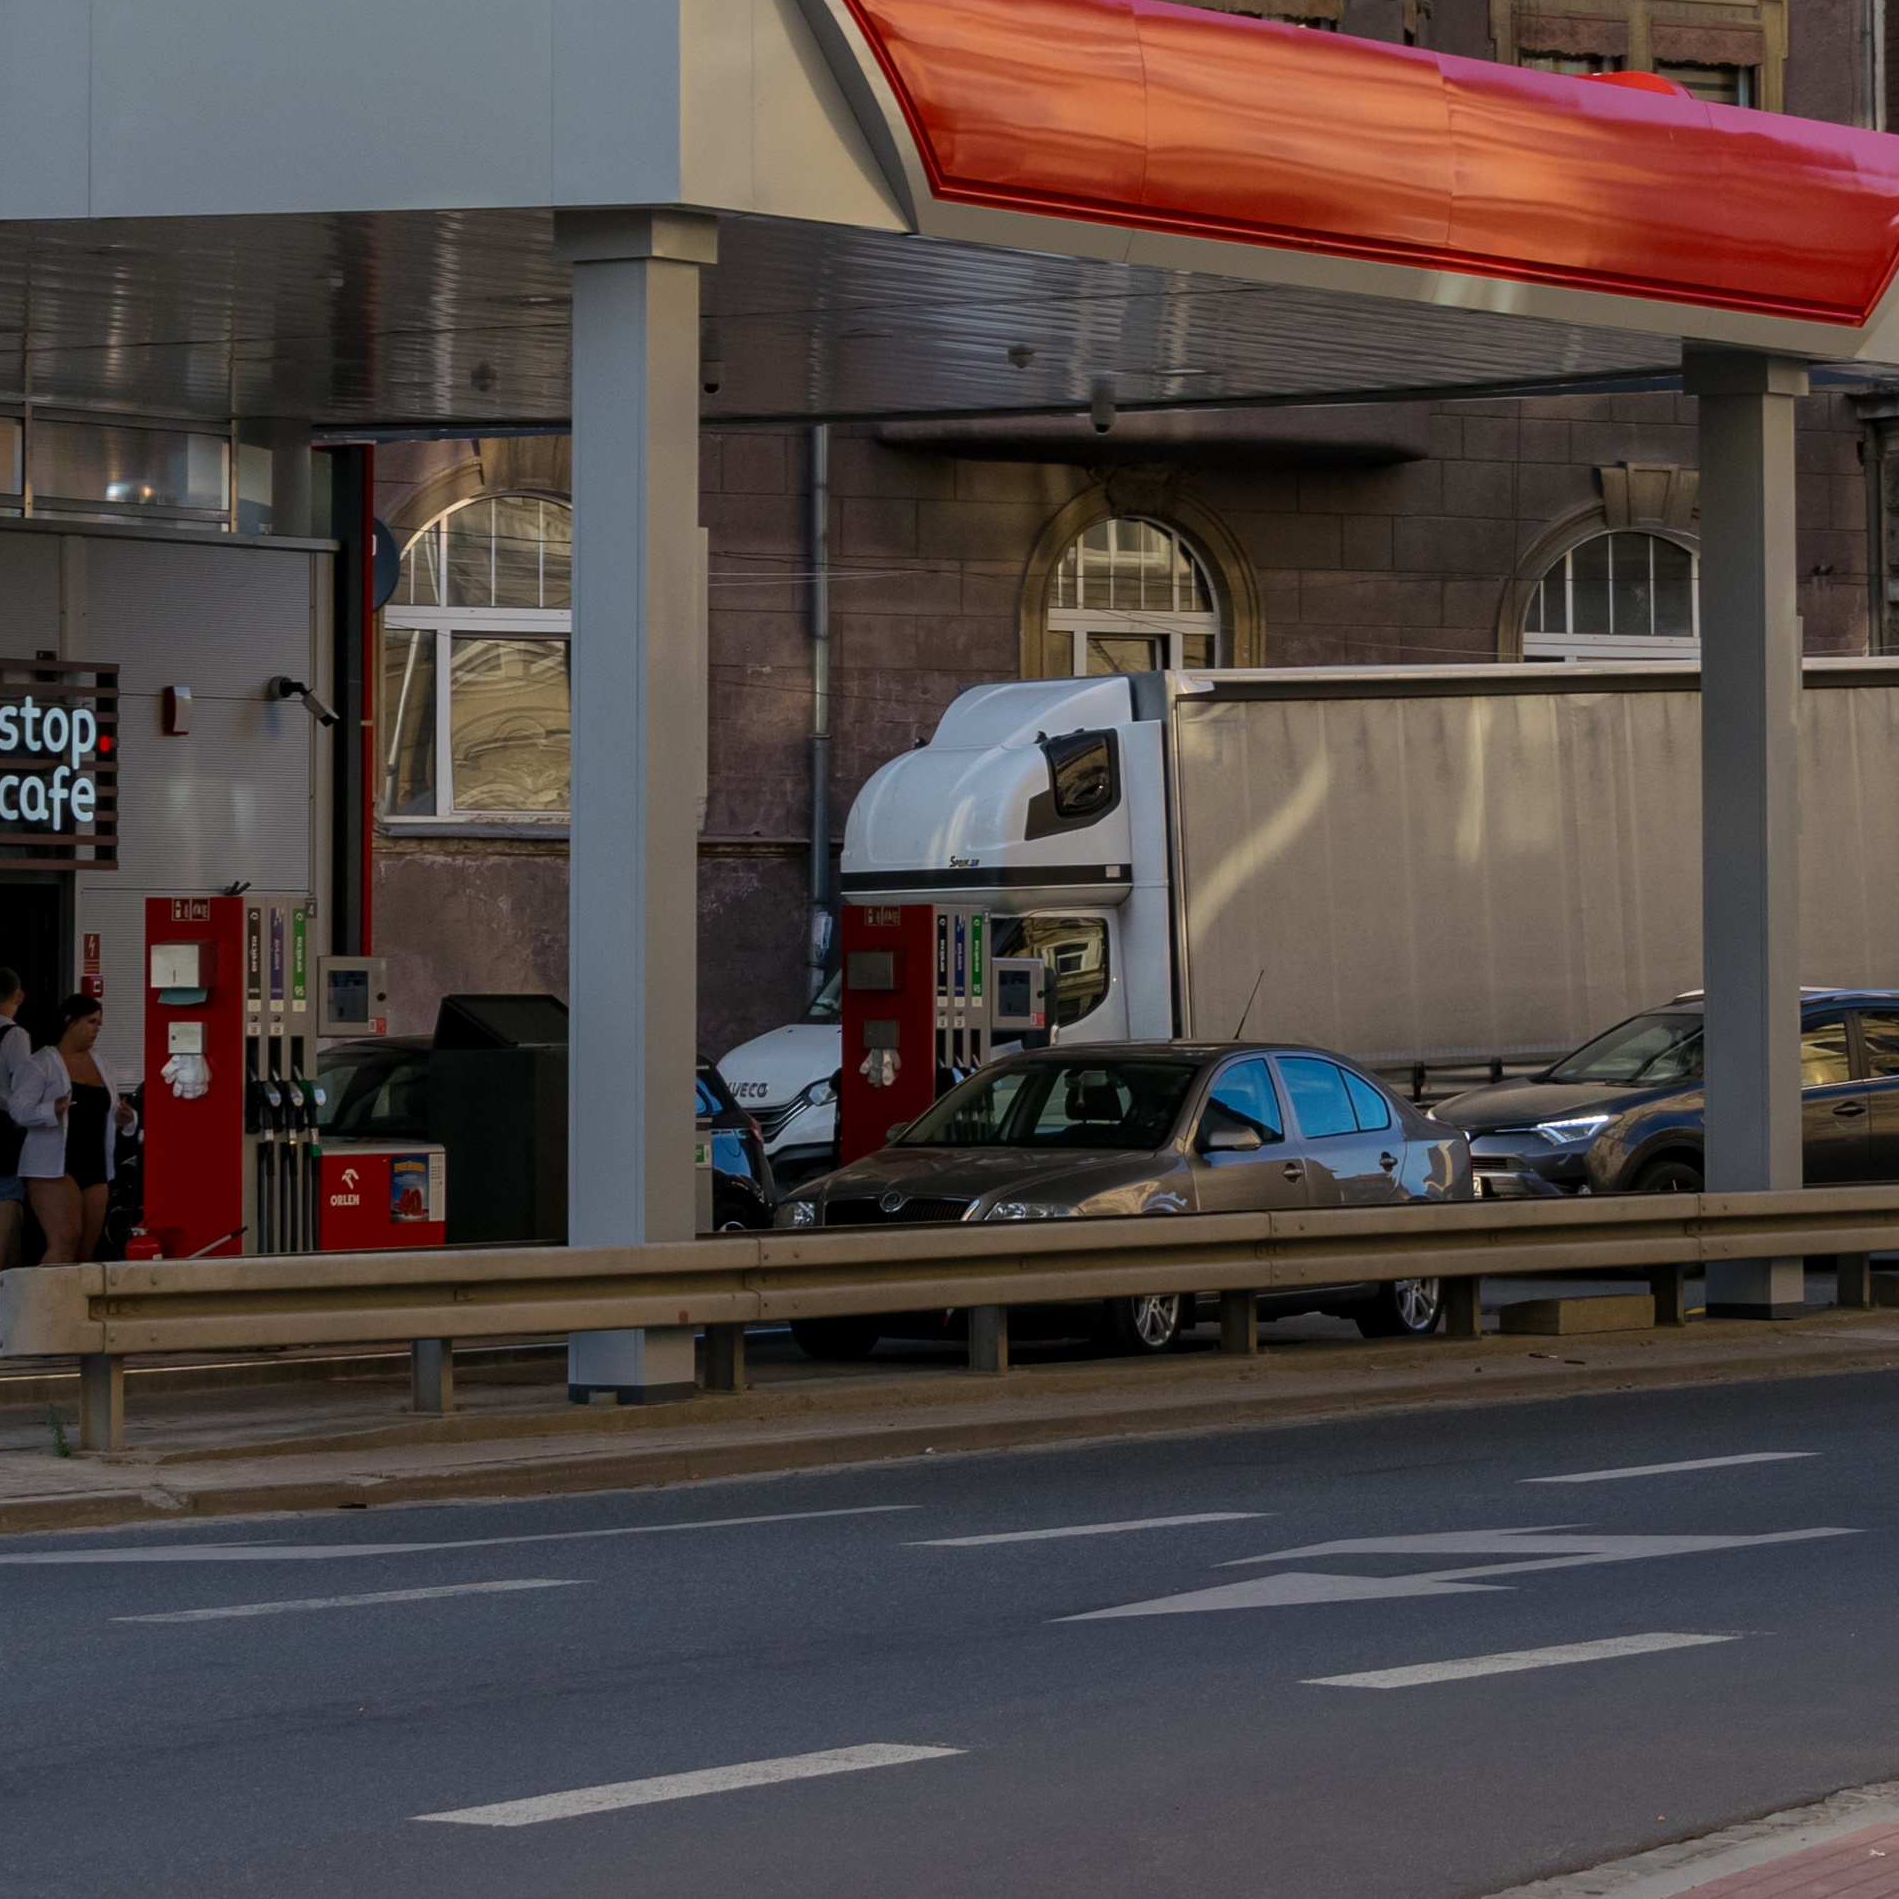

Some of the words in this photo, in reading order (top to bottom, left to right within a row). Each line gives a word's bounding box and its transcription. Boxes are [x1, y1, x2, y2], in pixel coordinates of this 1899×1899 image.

[307, 904, 314, 916] 4
[294, 985, 304, 997] 95
[330, 1194, 360, 1207] ORLEN
